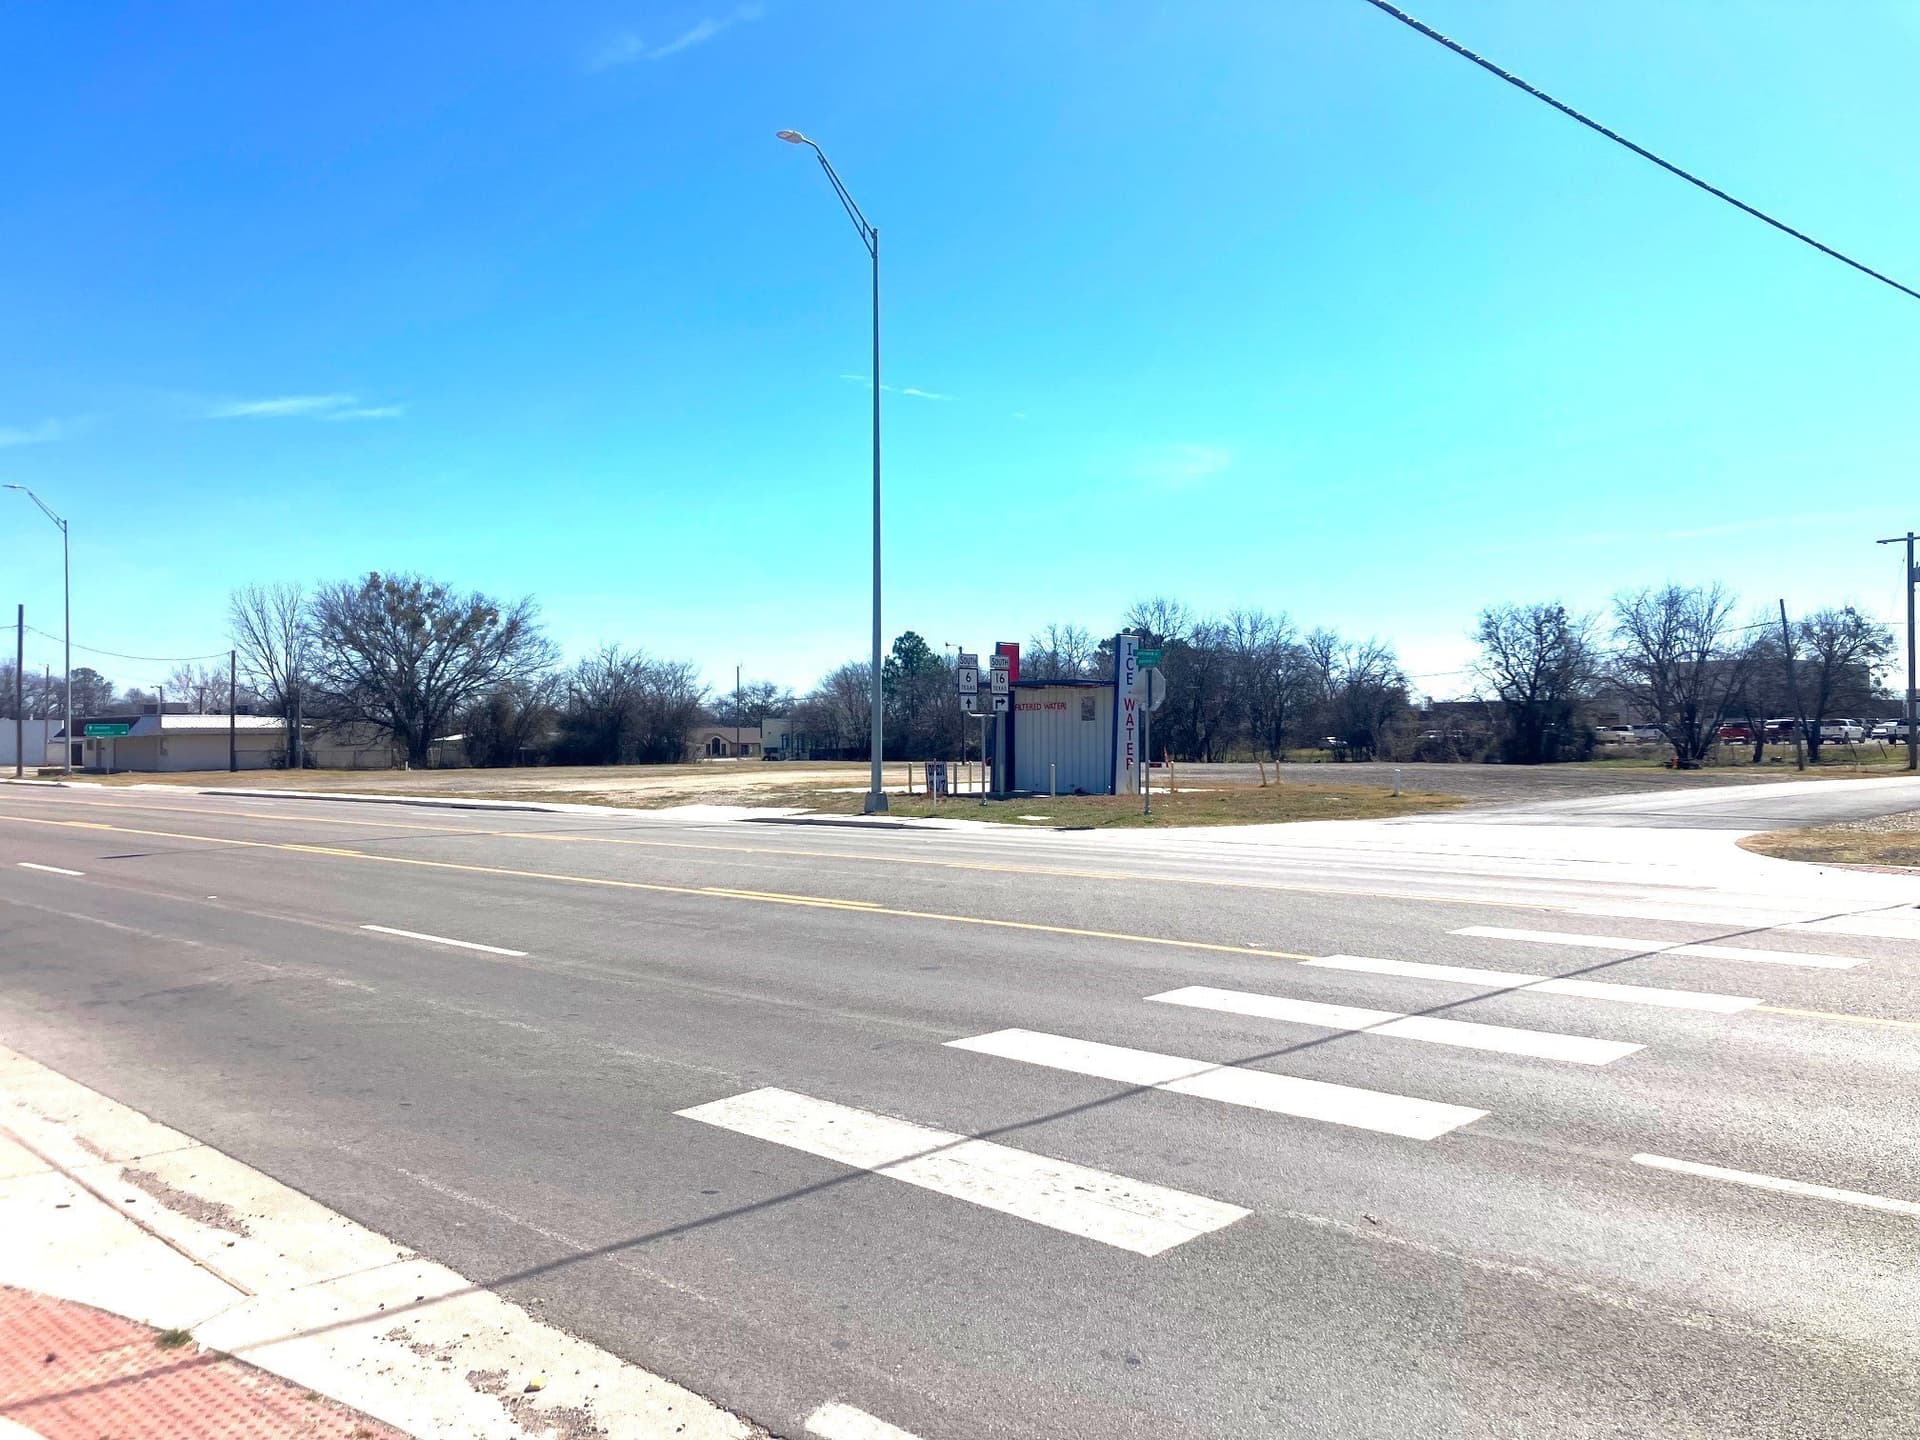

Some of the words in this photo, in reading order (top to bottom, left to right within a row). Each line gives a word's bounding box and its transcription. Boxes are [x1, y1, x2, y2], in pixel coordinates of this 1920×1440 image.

[959, 655, 977, 665] SOUTH
[991, 657, 1009, 666] SOUTH
[1126, 642, 1134, 685] ICE
[965, 672, 972, 683] 6
[995, 673, 1005, 683] 16
[1043, 702, 1067, 710] WATER
